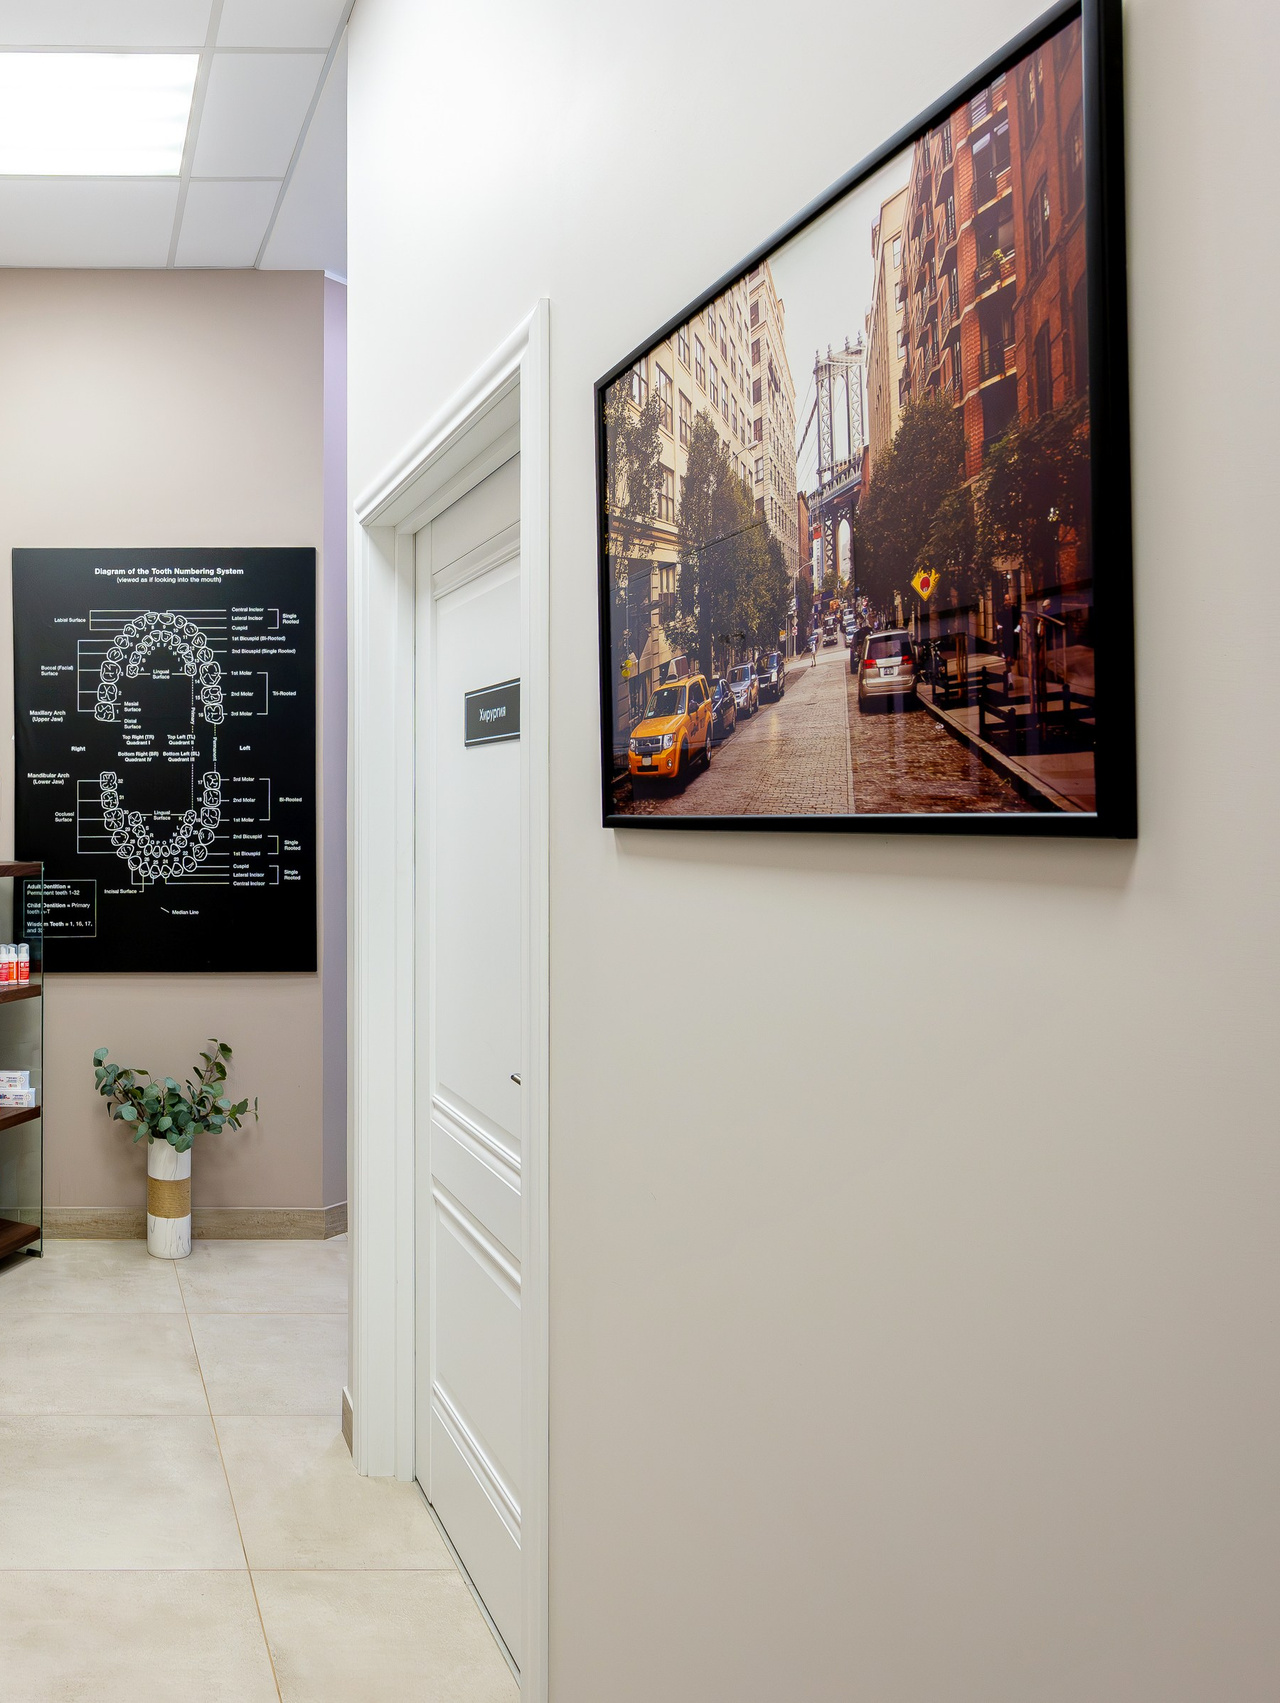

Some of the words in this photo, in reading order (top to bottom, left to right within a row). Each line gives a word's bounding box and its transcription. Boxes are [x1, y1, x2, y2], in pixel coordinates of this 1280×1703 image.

[94, 568, 126, 576] Diagram
[128, 568, 136, 576] of
[137, 568, 149, 576] the
[152, 568, 172, 576] Tooth
[174, 568, 215, 576] Numbering
[216, 568, 244, 576] System
[479, 706, 506, 723] Хирургия
